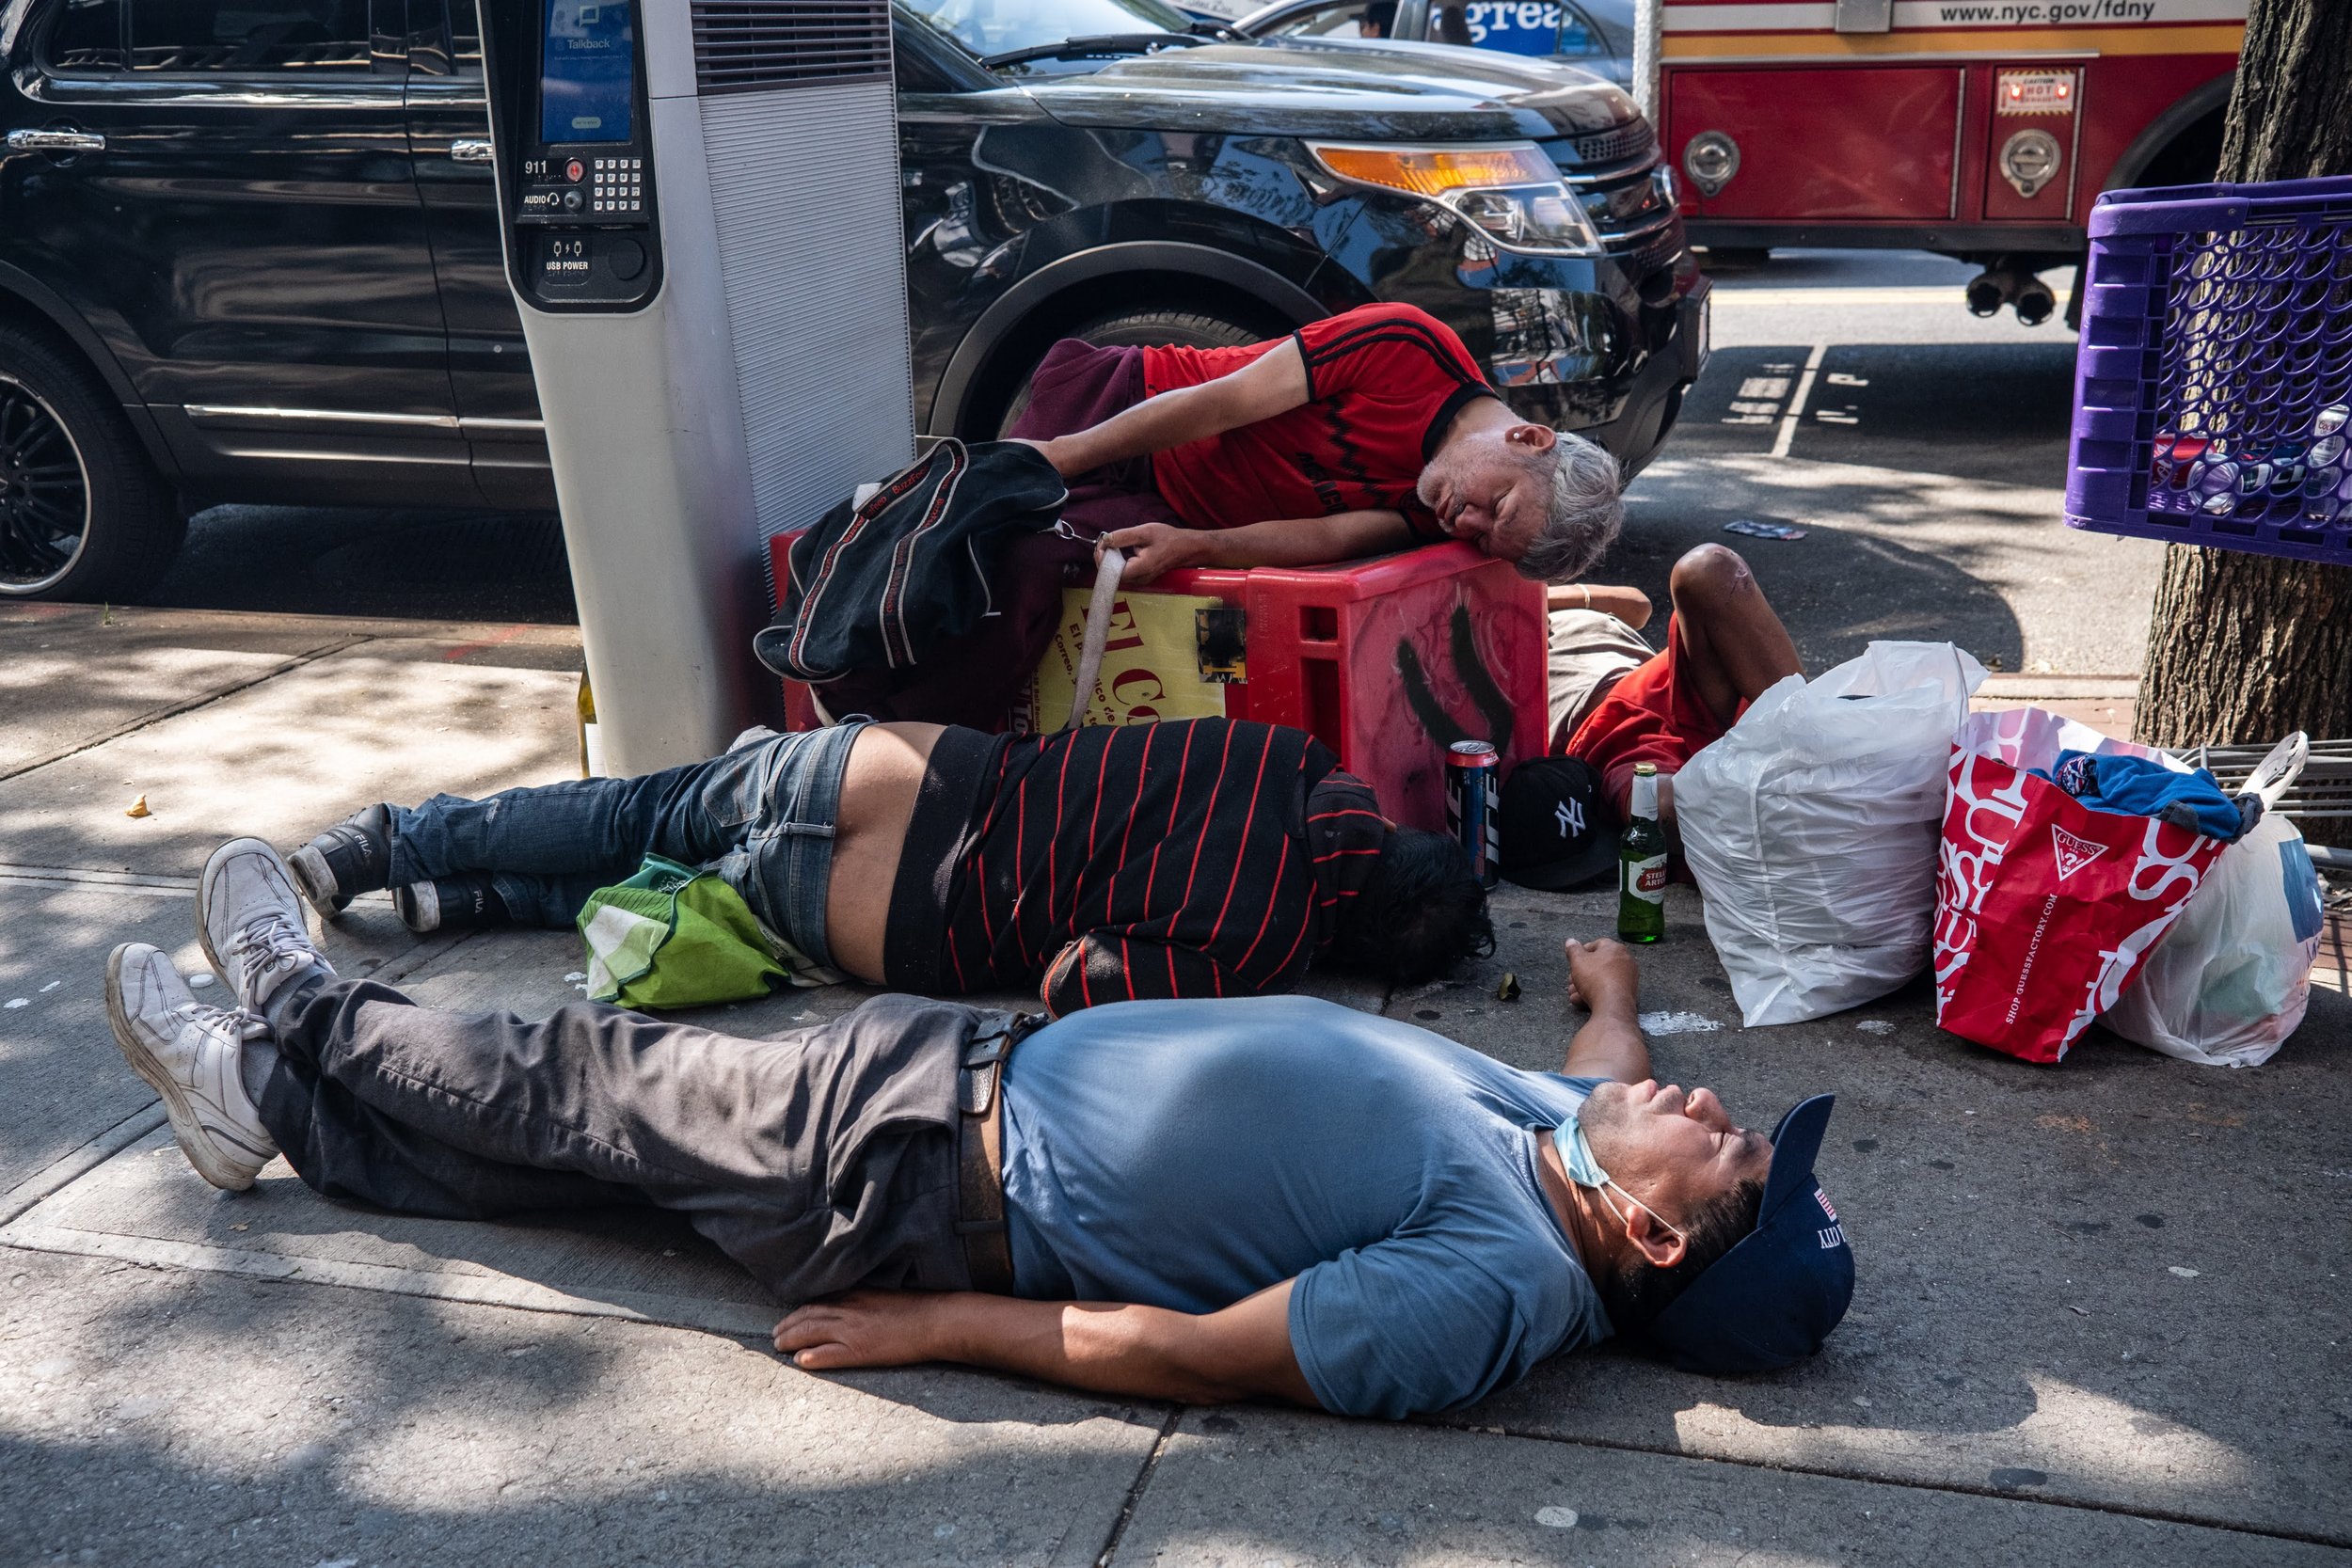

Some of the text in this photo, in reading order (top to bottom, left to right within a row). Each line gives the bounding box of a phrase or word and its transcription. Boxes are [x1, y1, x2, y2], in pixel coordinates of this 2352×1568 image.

[1941, 0, 2155, 23] www.nyc.gov/fdny
[567, 39, 611, 49] Talkback
[525, 160, 547, 174] 911
[524, 196, 546, 204] AUDIO
[546, 261, 588, 270] USB POWER
[1055, 633, 1073, 675] Correo,
[1069, 623, 1080, 639] El
[1104, 706, 1116, 722] de
[1554, 796, 1586, 838] NY
[354, 833, 373, 858] FILA
[2057, 832, 2097, 856] GUESS
[473, 889, 485, 914] FILA
[2006, 893, 2058, 1024] SHOP GUESSFACTORY.COM
[1817, 1226, 1841, 1249] CITY
